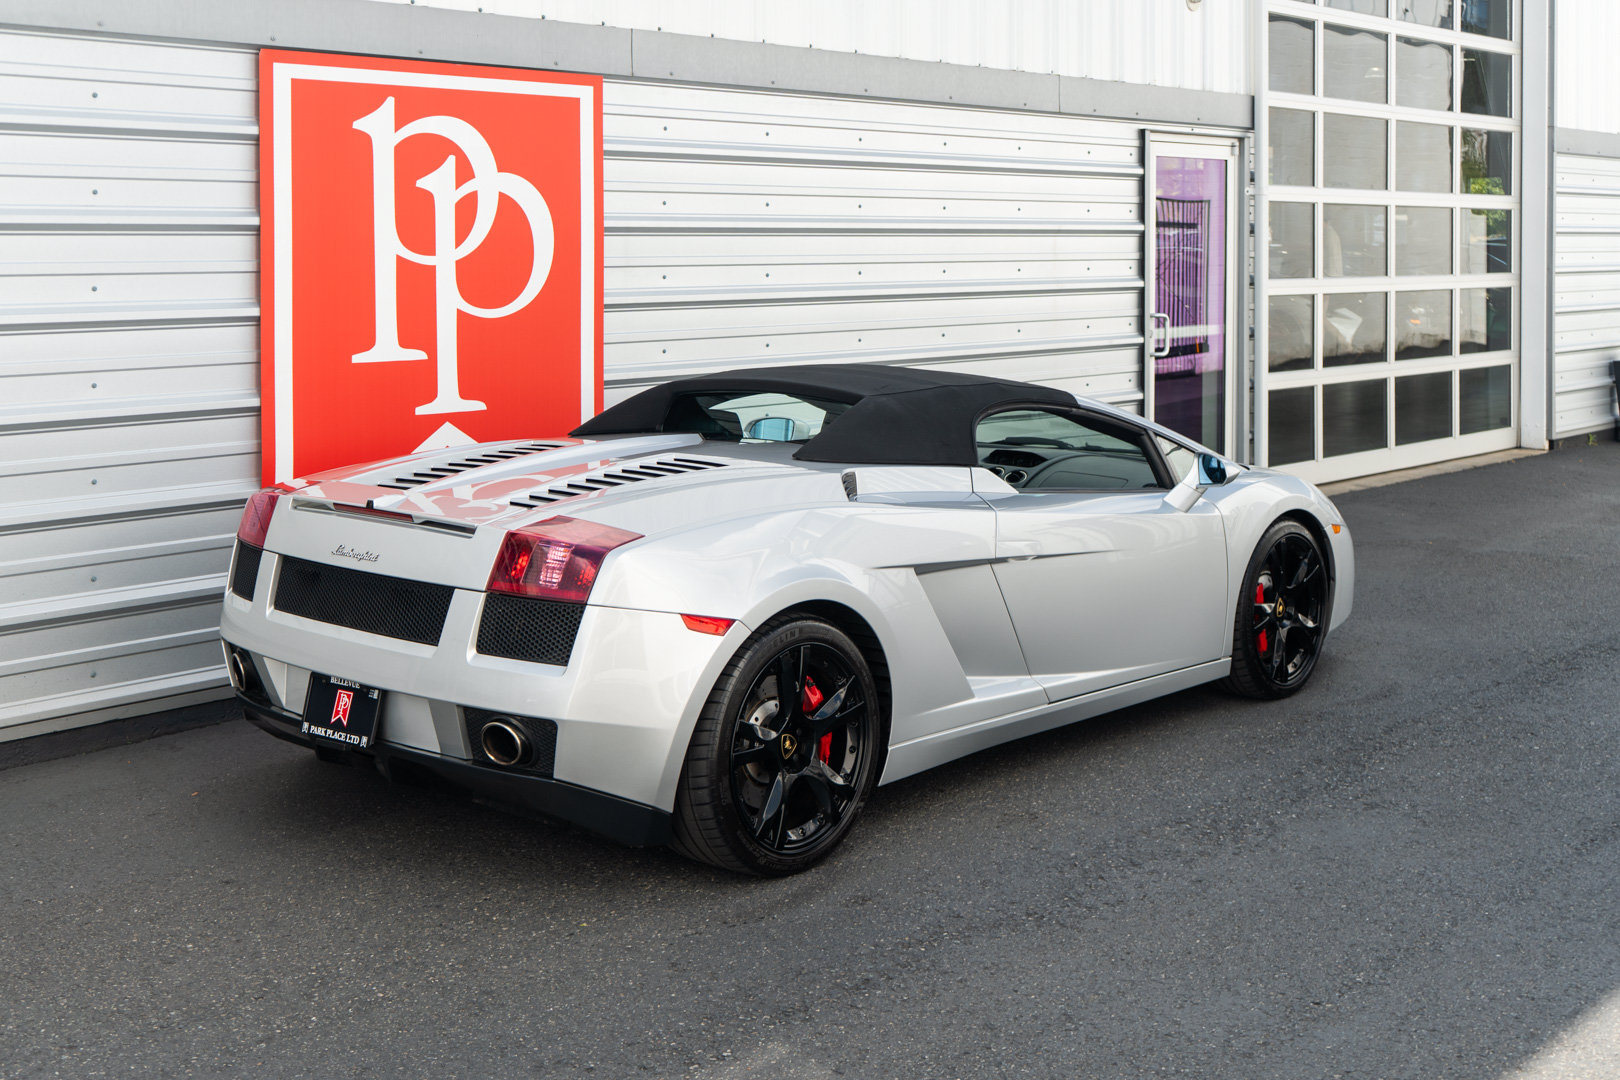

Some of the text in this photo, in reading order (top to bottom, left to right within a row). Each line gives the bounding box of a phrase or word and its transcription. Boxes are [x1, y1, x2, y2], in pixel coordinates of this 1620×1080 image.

[330, 676, 361, 689] BELLEVUE
[310, 725, 327, 737] PARK
[326, 729, 347, 742] PLACE
[346, 734, 360, 745] LTD
